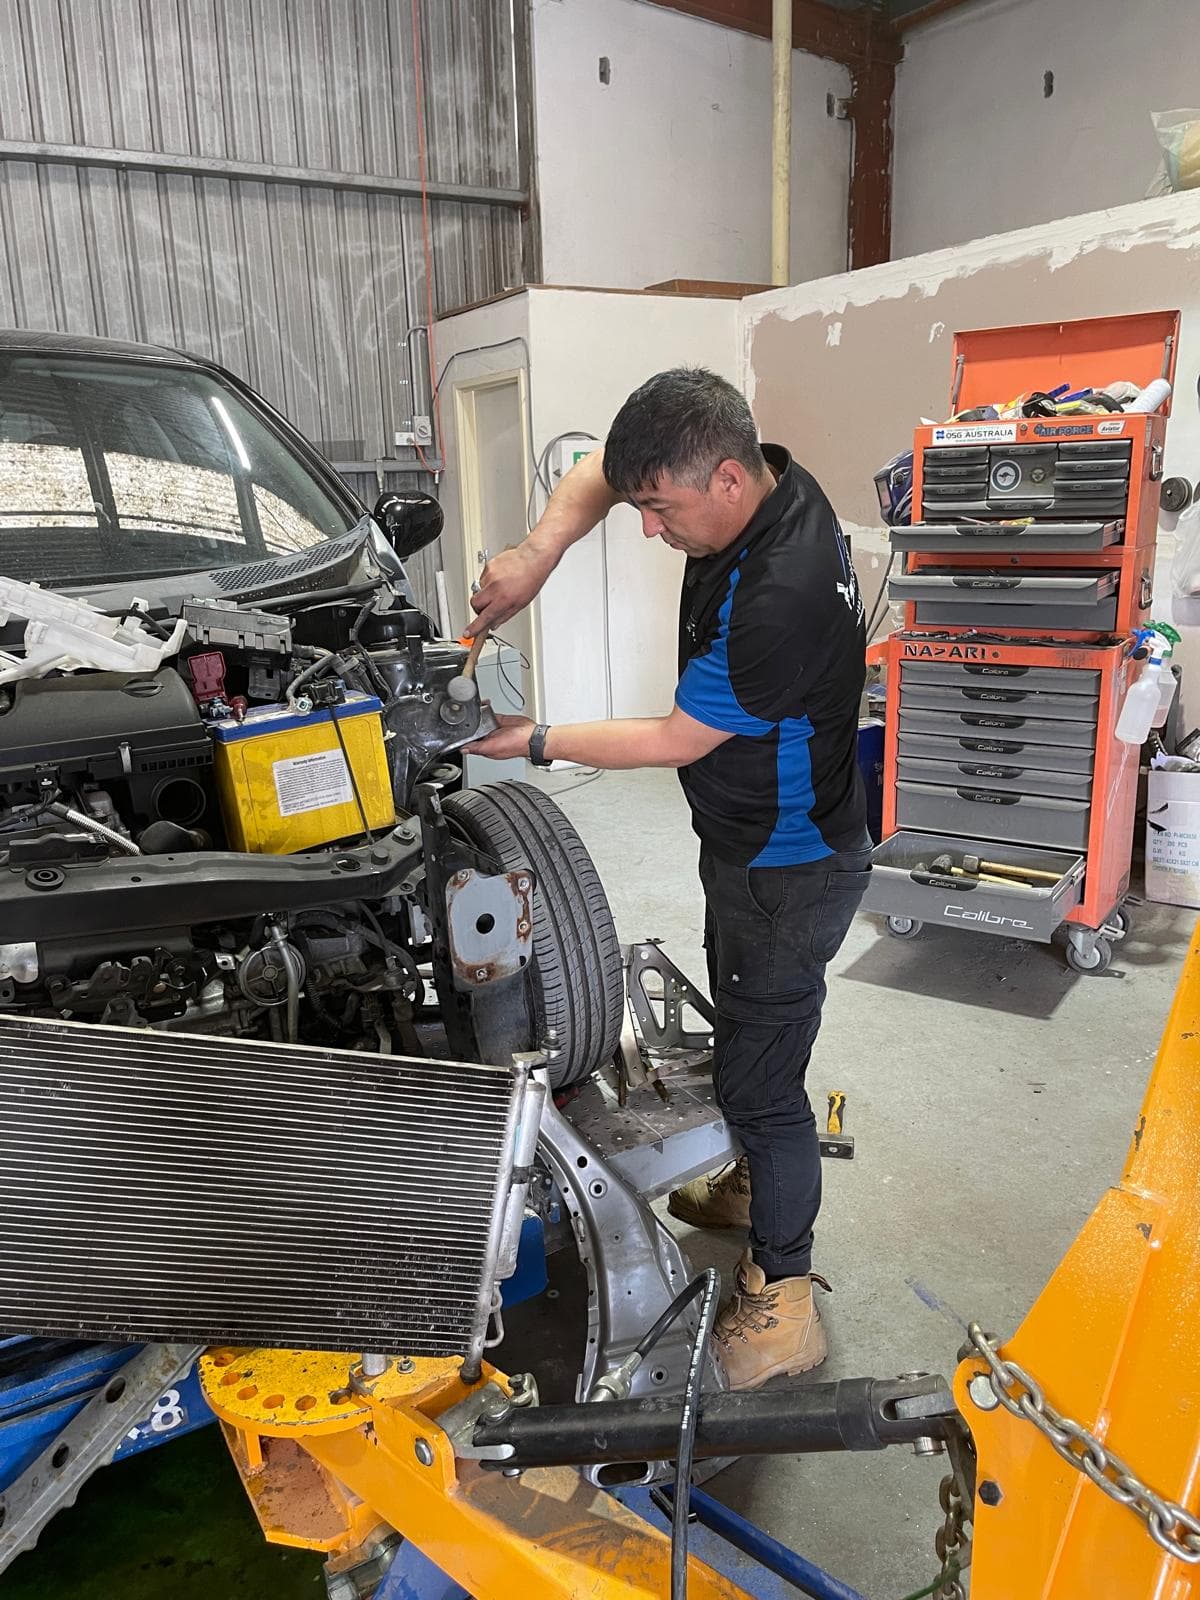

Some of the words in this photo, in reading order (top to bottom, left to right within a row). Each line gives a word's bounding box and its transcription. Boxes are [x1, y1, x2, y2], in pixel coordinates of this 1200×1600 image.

[965, 429, 1013, 438] AUSTRALIA
[1041, 427, 1057, 436] AIR
[1058, 425, 1093, 435] FORCE
[943, 904, 1034, 930] Calibre
